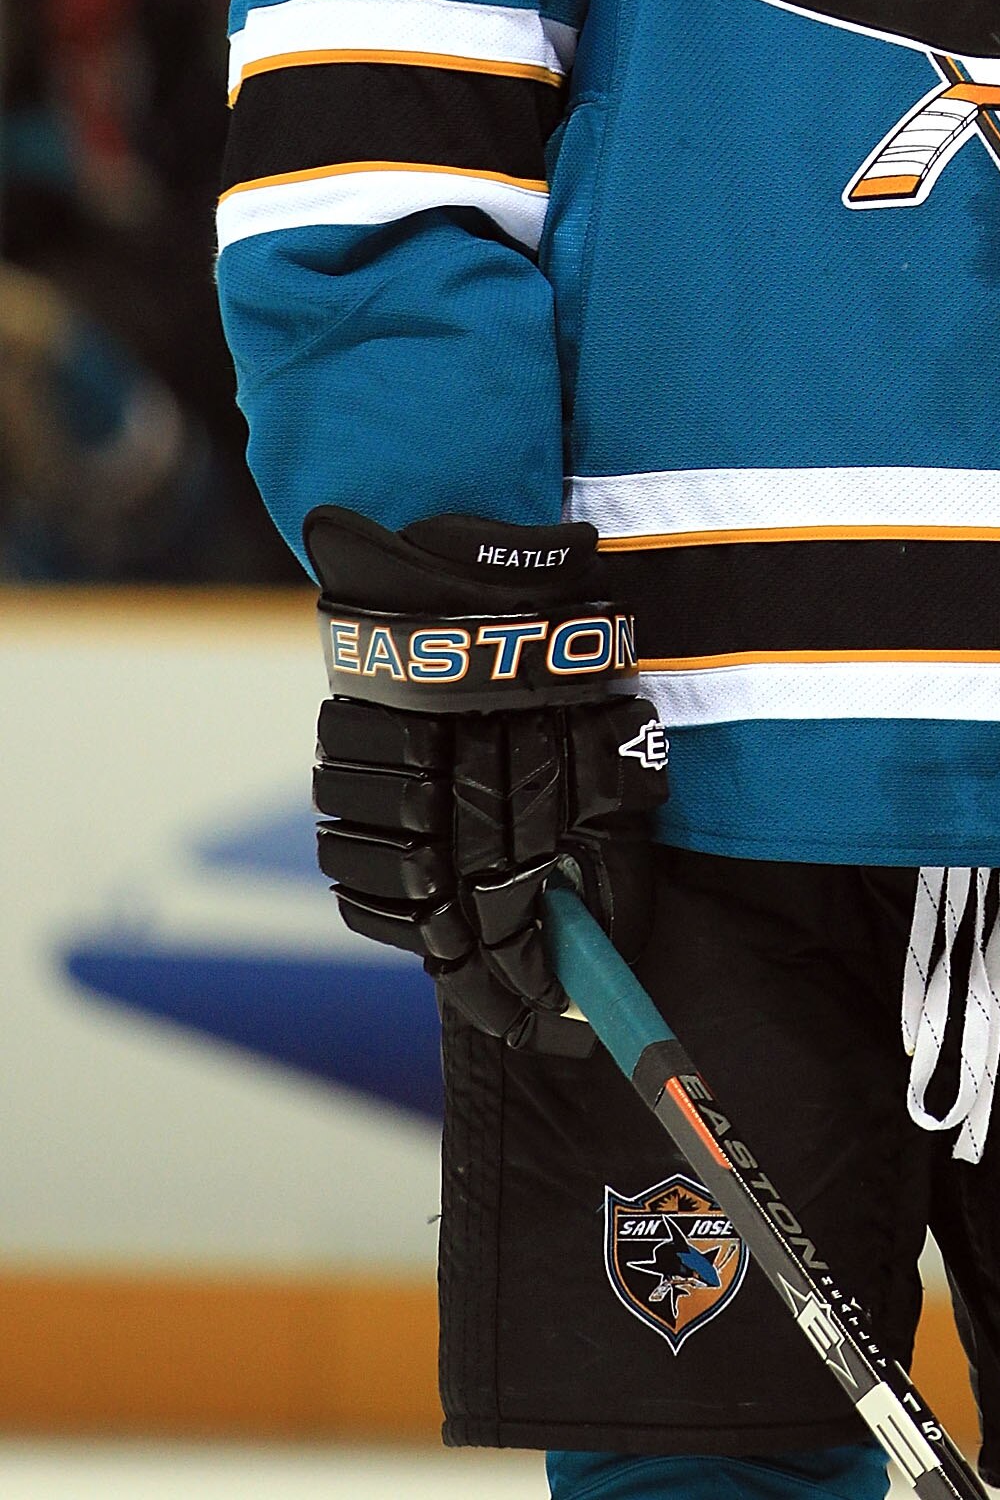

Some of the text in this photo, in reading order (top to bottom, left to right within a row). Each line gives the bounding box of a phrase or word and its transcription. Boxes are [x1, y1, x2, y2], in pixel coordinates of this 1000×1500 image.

[477, 544, 570, 568] HEATLEY
[329, 614, 638, 683] EASTON
[679, 1074, 830, 1270] EASTON
[619, 1219, 733, 1238] SAN JOSE
[821, 1275, 887, 1368] HEATLEY
[903, 1392, 943, 1442] 15
